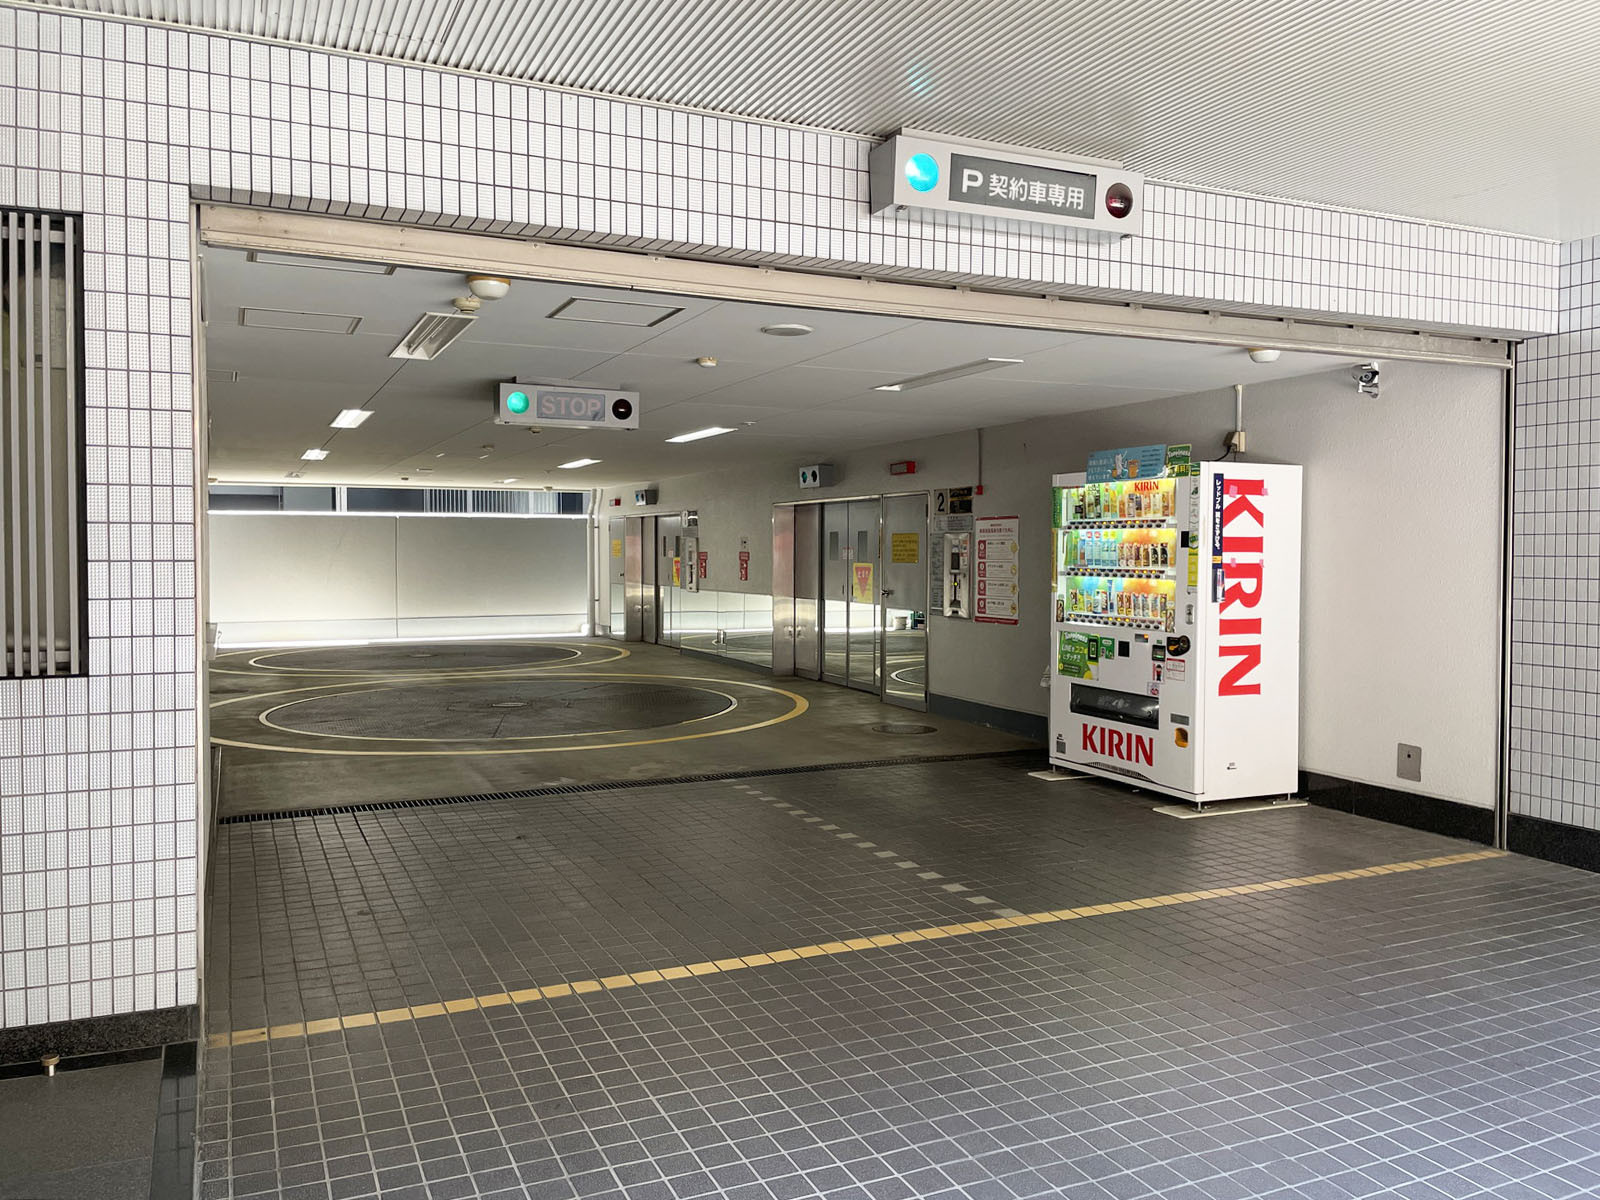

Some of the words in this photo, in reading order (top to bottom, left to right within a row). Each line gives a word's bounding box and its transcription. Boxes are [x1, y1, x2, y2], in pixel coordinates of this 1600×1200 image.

[962, 168, 984, 193] P
[989, 173, 1085, 210] 契約車専用
[541, 396, 602, 417] STOP
[1134, 480, 1159, 492] KIRIN
[937, 492, 945, 512] 2
[1218, 479, 1265, 696] KIRIN
[1082, 722, 1154, 767] KIRIN
